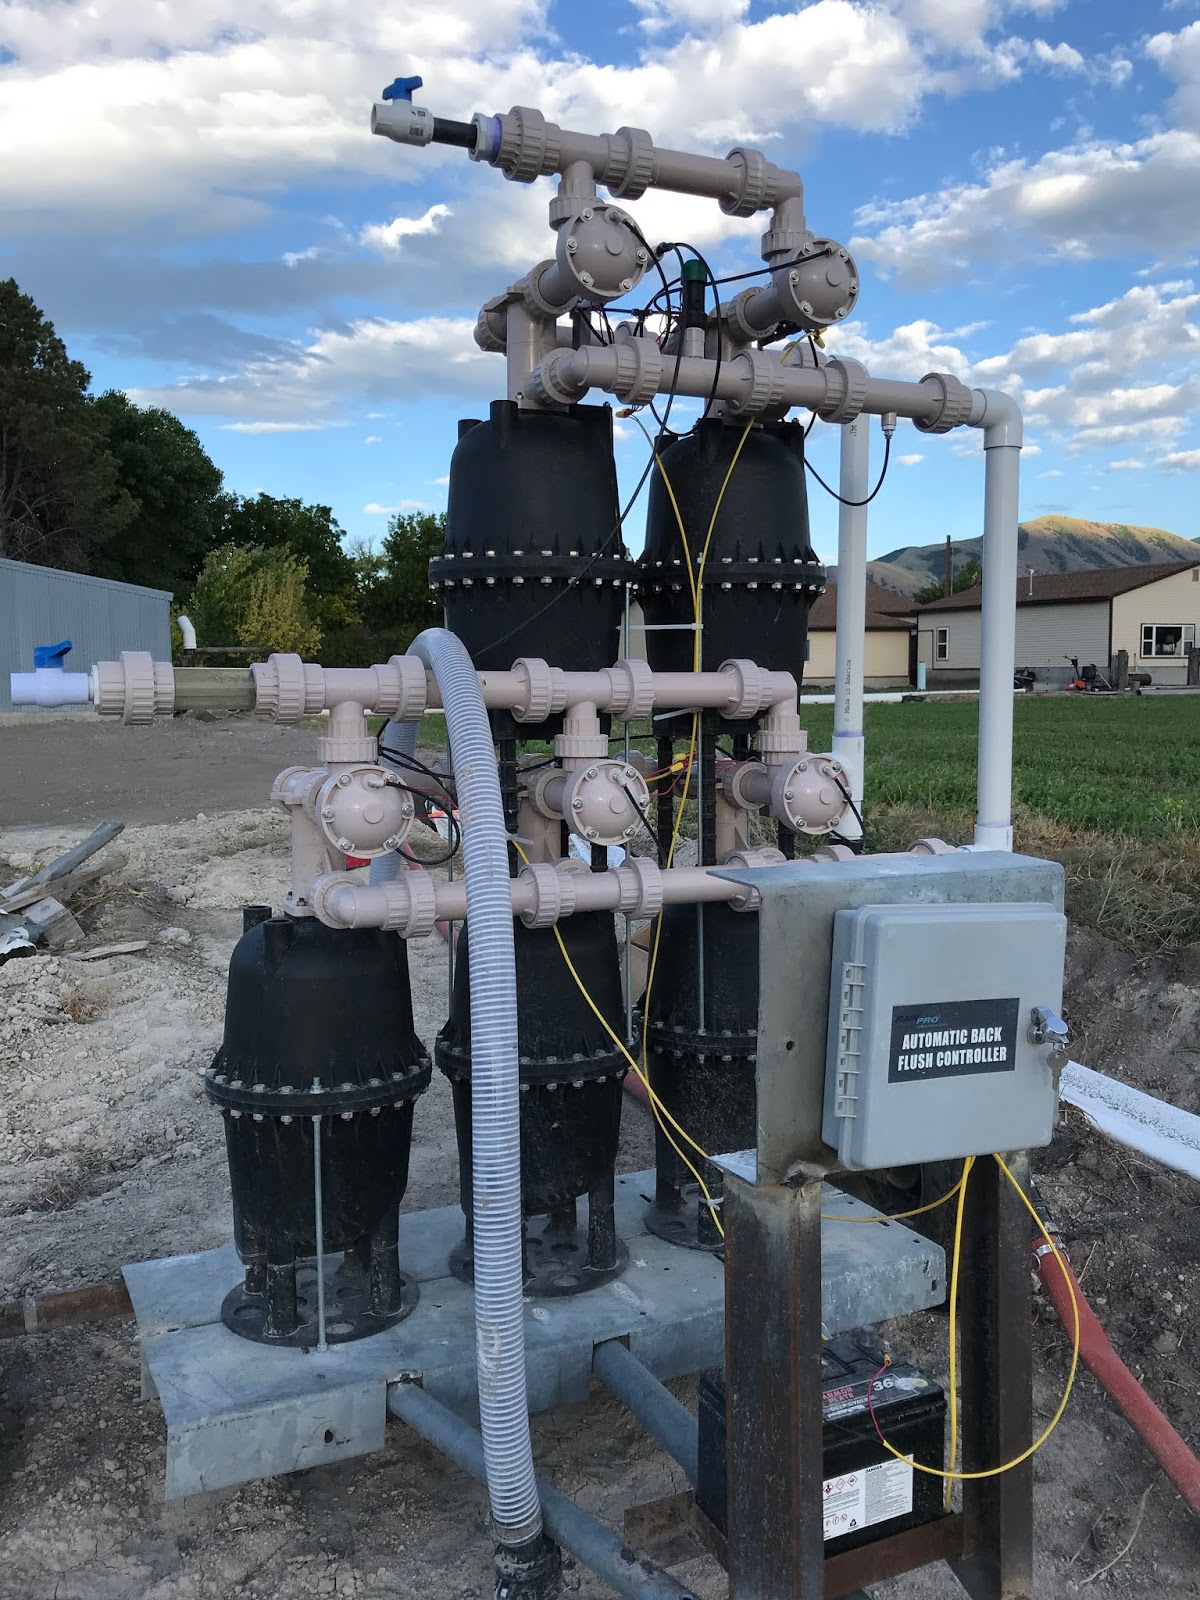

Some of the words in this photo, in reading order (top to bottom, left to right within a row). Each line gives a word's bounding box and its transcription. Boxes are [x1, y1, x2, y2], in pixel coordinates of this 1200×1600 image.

[844, 659, 852, 685] America
[902, 1029, 968, 1050] AUTOMATIC
[970, 1027, 1003, 1044] BACK
[897, 1053, 933, 1071] FLUSH
[936, 1047, 1007, 1067] CONTROLLER
[872, 1378, 894, 1391] 36
